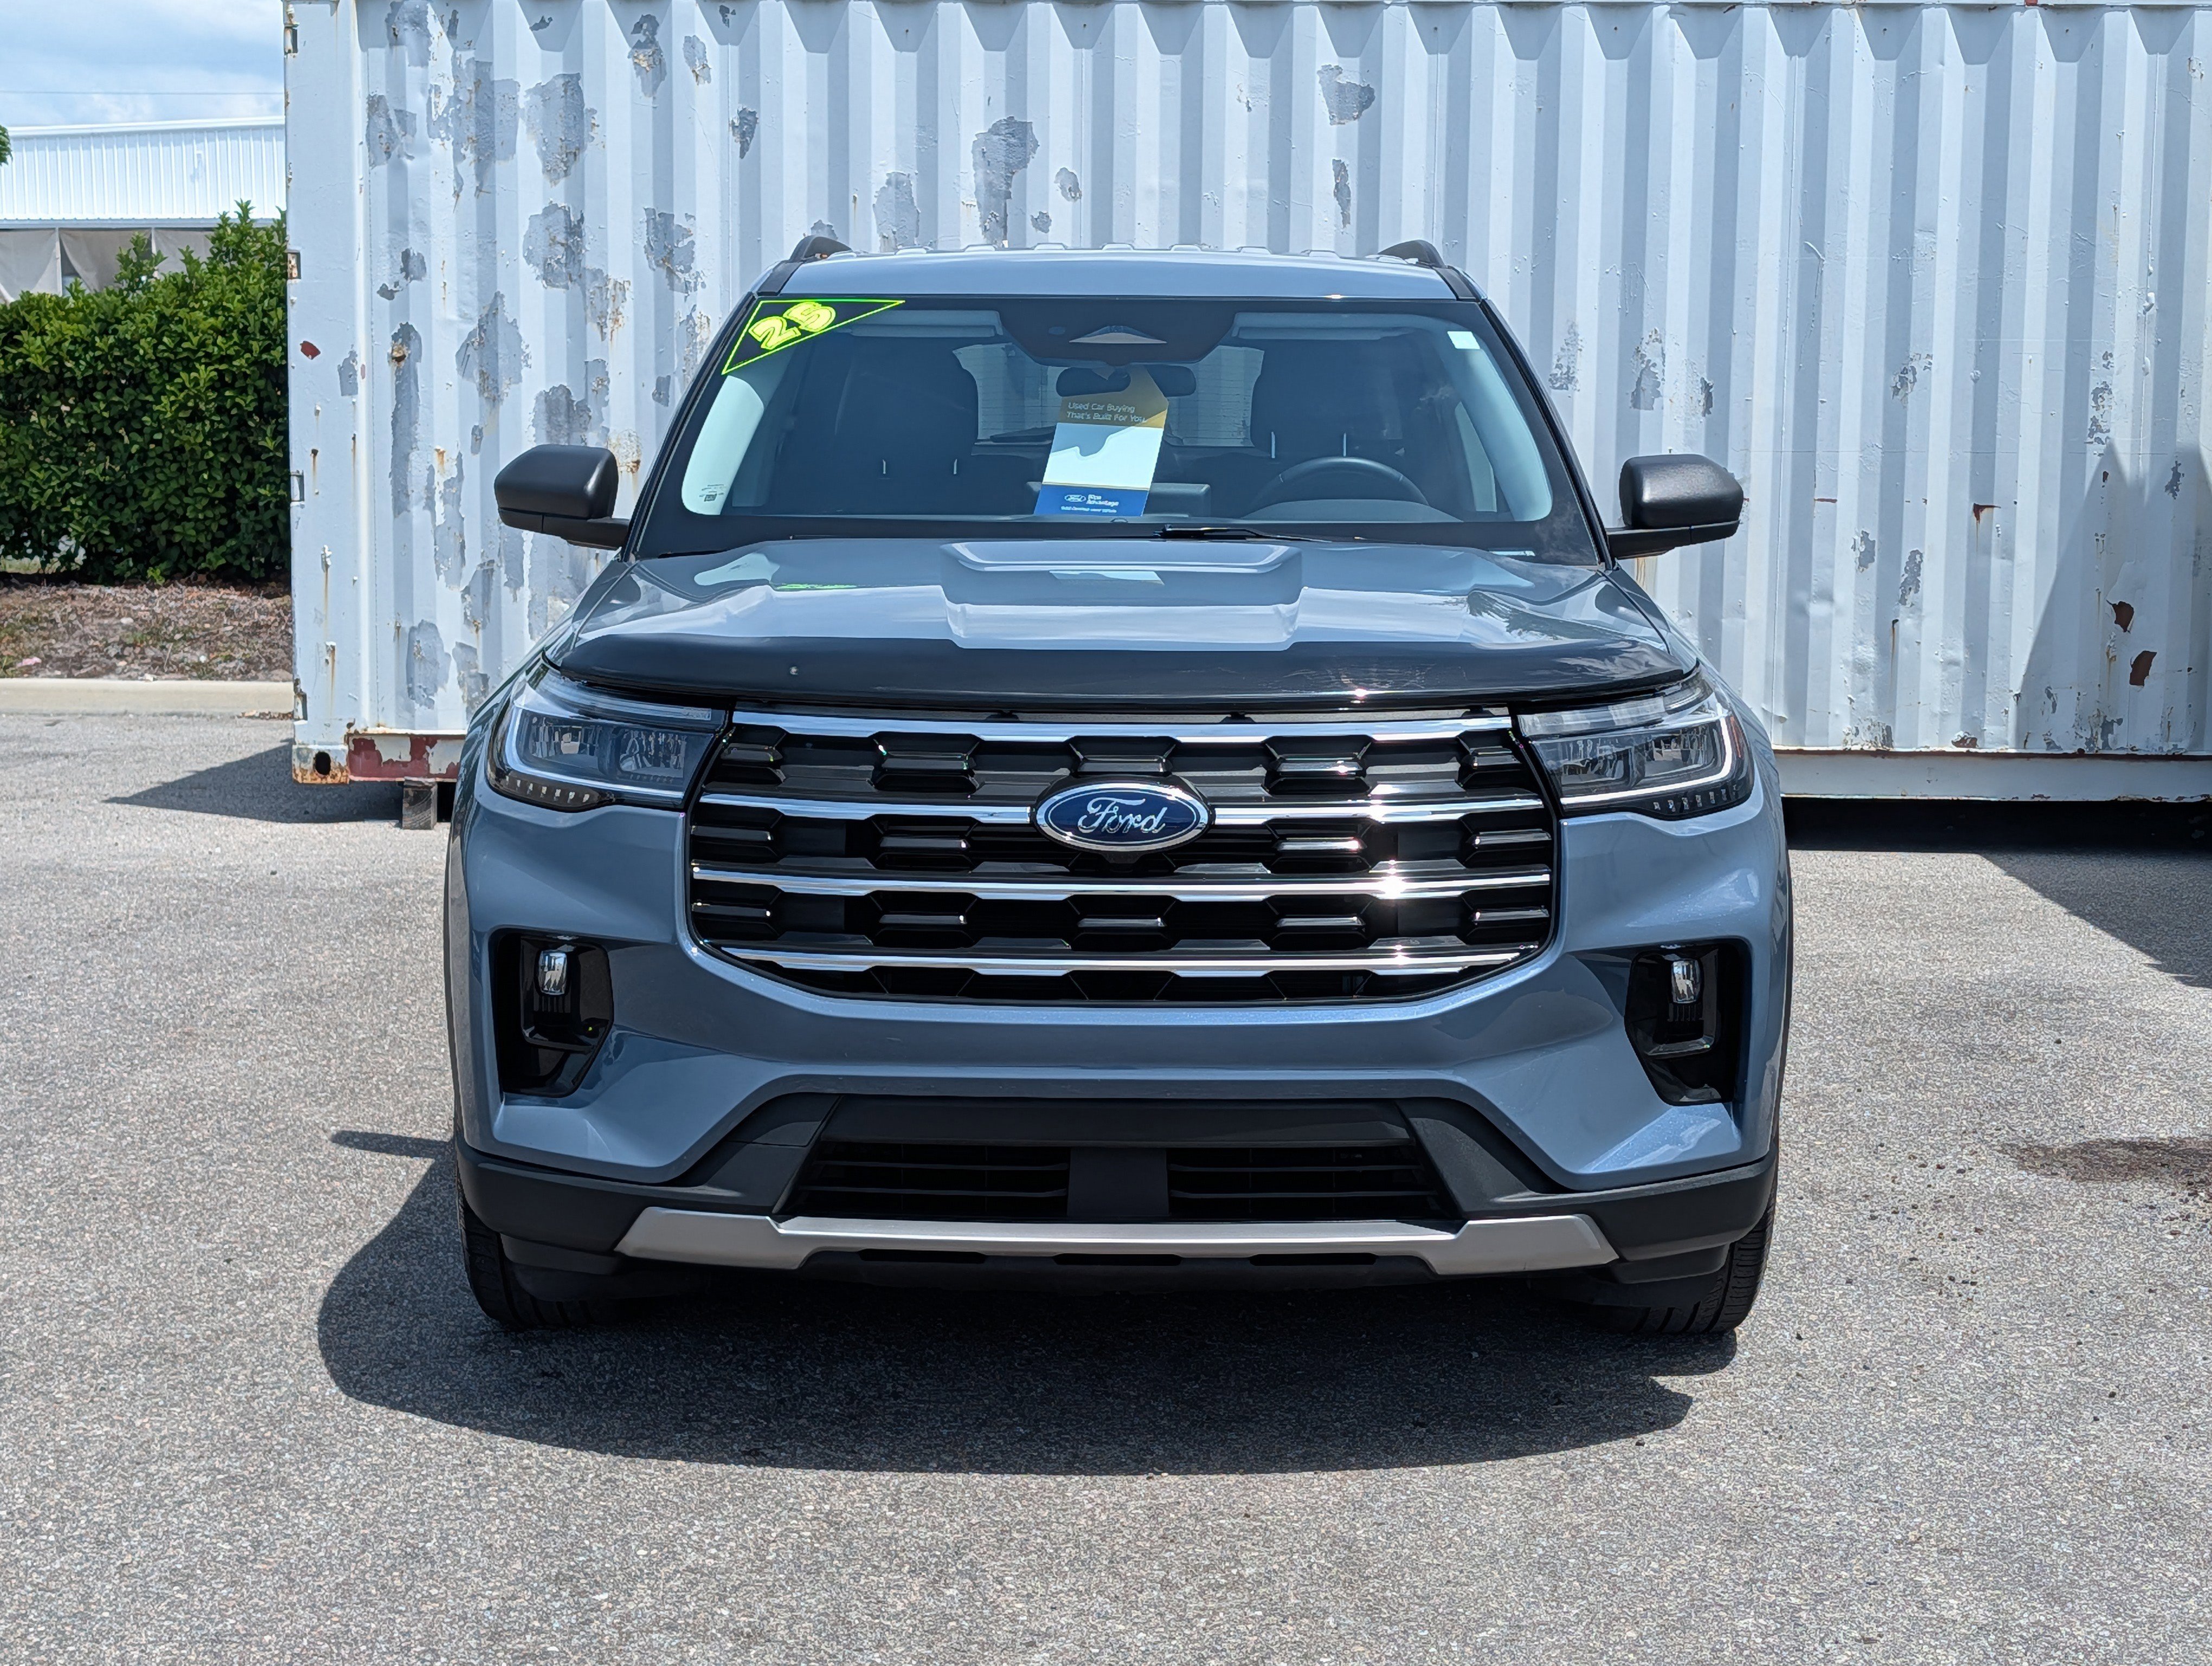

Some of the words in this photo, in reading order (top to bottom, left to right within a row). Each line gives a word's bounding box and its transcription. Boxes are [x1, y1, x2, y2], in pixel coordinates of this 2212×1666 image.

[748, 302, 836, 350] 25
[1067, 411, 1091, 420] That's
[1068, 402, 1089, 410] Used
[1107, 403, 1135, 413] Buying
[1077, 797, 1167, 834] Ford
